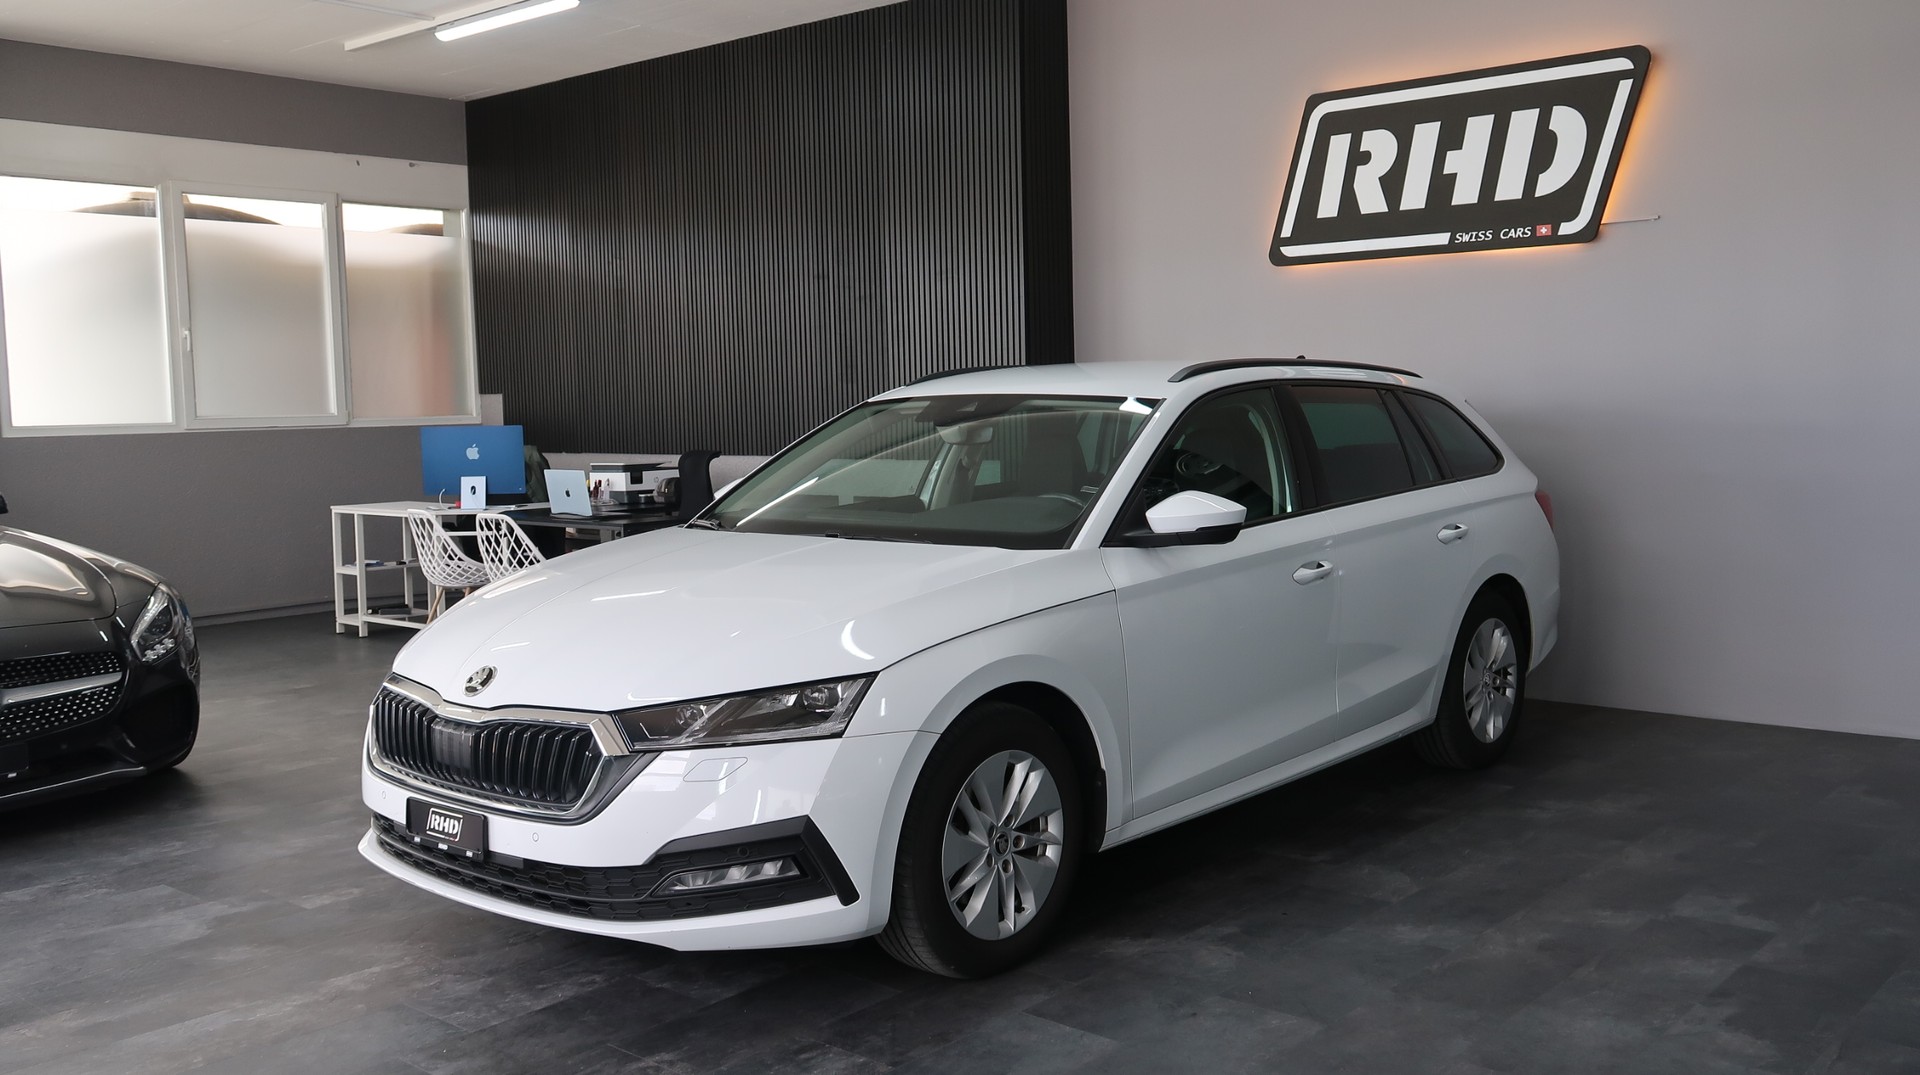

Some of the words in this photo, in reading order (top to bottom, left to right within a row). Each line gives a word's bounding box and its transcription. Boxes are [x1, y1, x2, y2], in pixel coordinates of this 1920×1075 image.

[1317, 105, 1588, 219] RHD
[1454, 230, 1493, 243] SWISS
[1500, 227, 1532, 239] CARS
[430, 814, 459, 835] RHD
